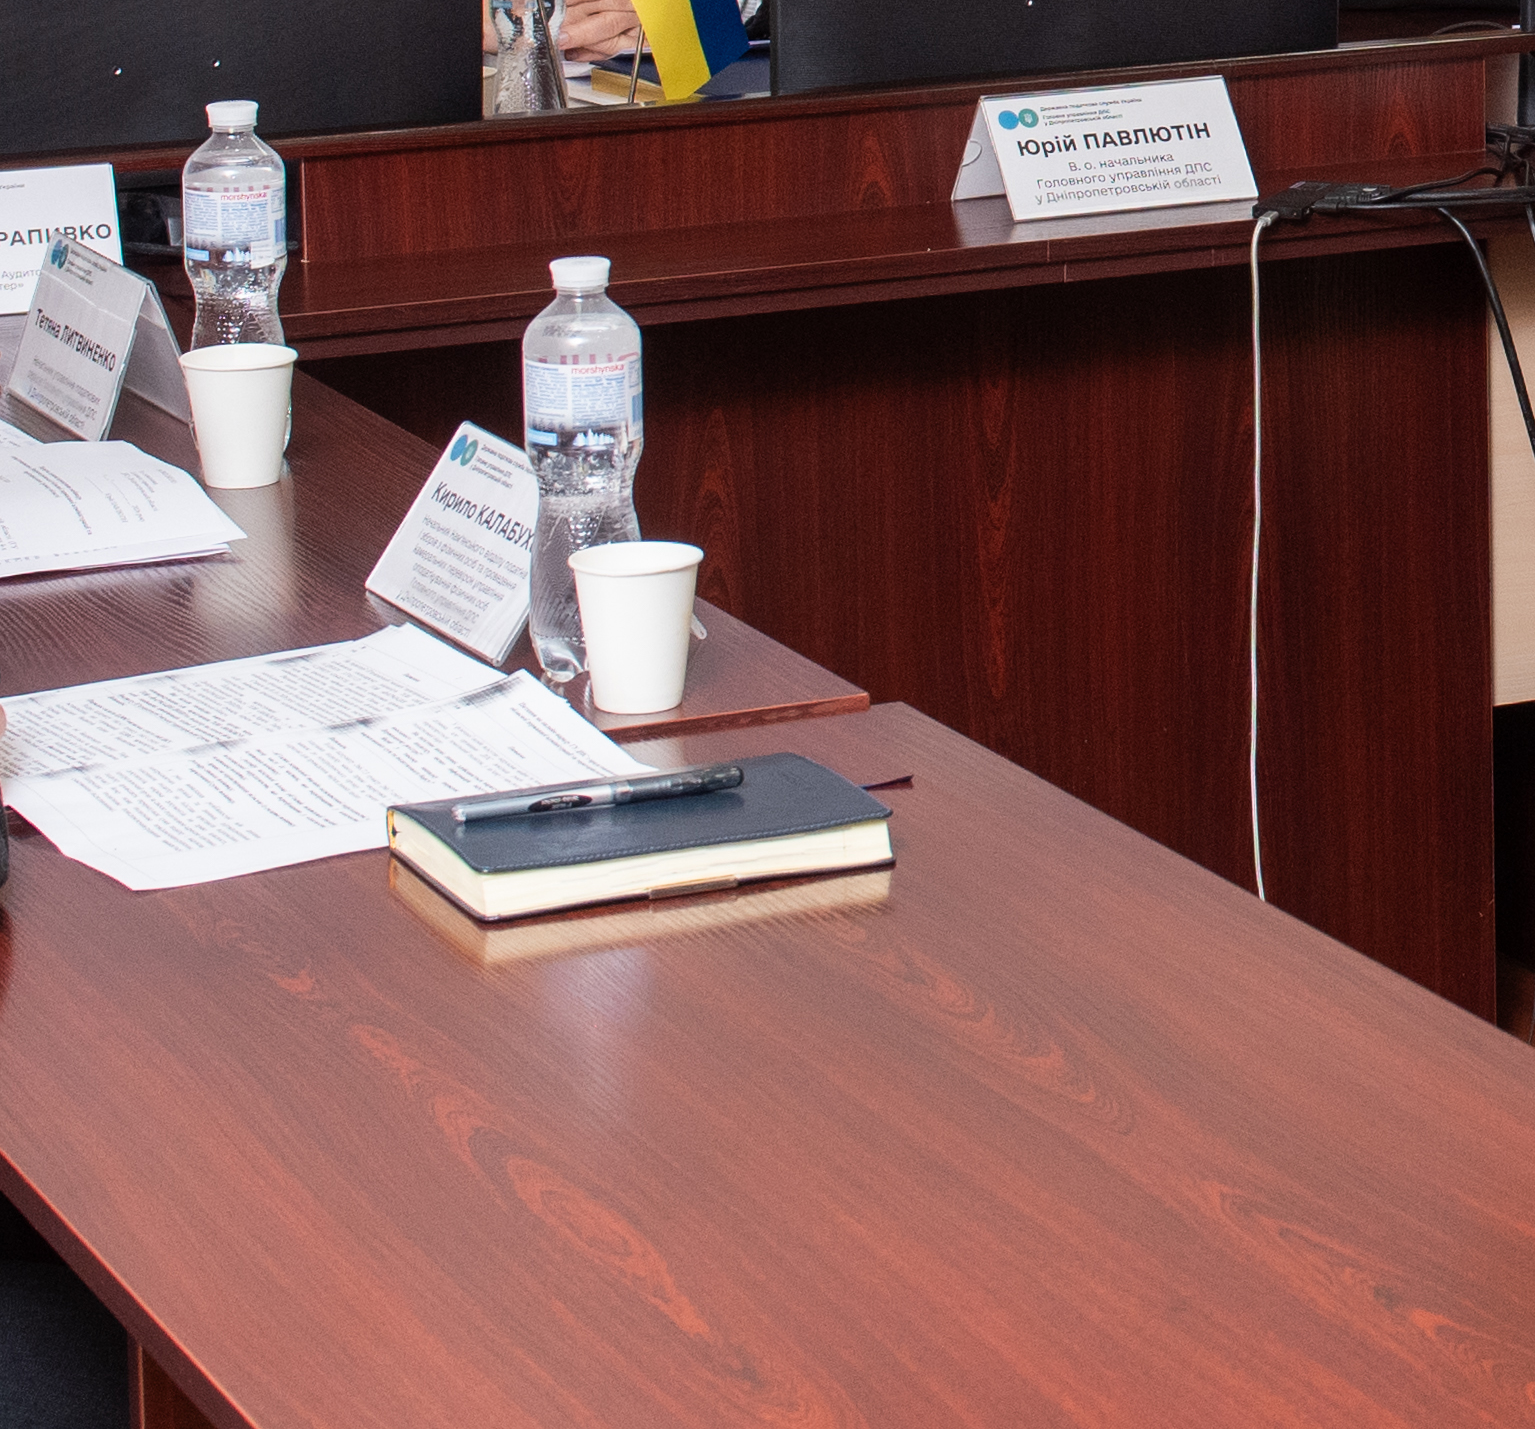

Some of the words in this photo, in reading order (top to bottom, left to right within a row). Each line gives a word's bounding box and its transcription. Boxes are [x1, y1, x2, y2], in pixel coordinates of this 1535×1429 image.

[1017, 134, 1077, 158] Юрій
[1083, 122, 1210, 149] ПАВЛЮТІН
[1036, 174, 1106, 189] Головного
[1108, 166, 1181, 183] управління
[1184, 161, 1212, 175] ДПС
[1068, 161, 1081, 171] В.
[1083, 161, 1096, 170] о.
[1098, 153, 1174, 168] начальника
[221, 191, 268, 201] morshynska
[1035, 195, 1042, 205] у
[1046, 179, 1171, 203] Дніпропетровській
[1173, 174, 1221, 189] області
[1, 267, 43, 280] Аудито
[35, 308, 61, 338] Тетяна
[59, 324, 115, 372] ЛИТВИНЕНКО
[571, 363, 625, 375] morshynska
[431, 481, 477, 519] Кирило
[474, 504, 535, 553] КАЛАБУХ
